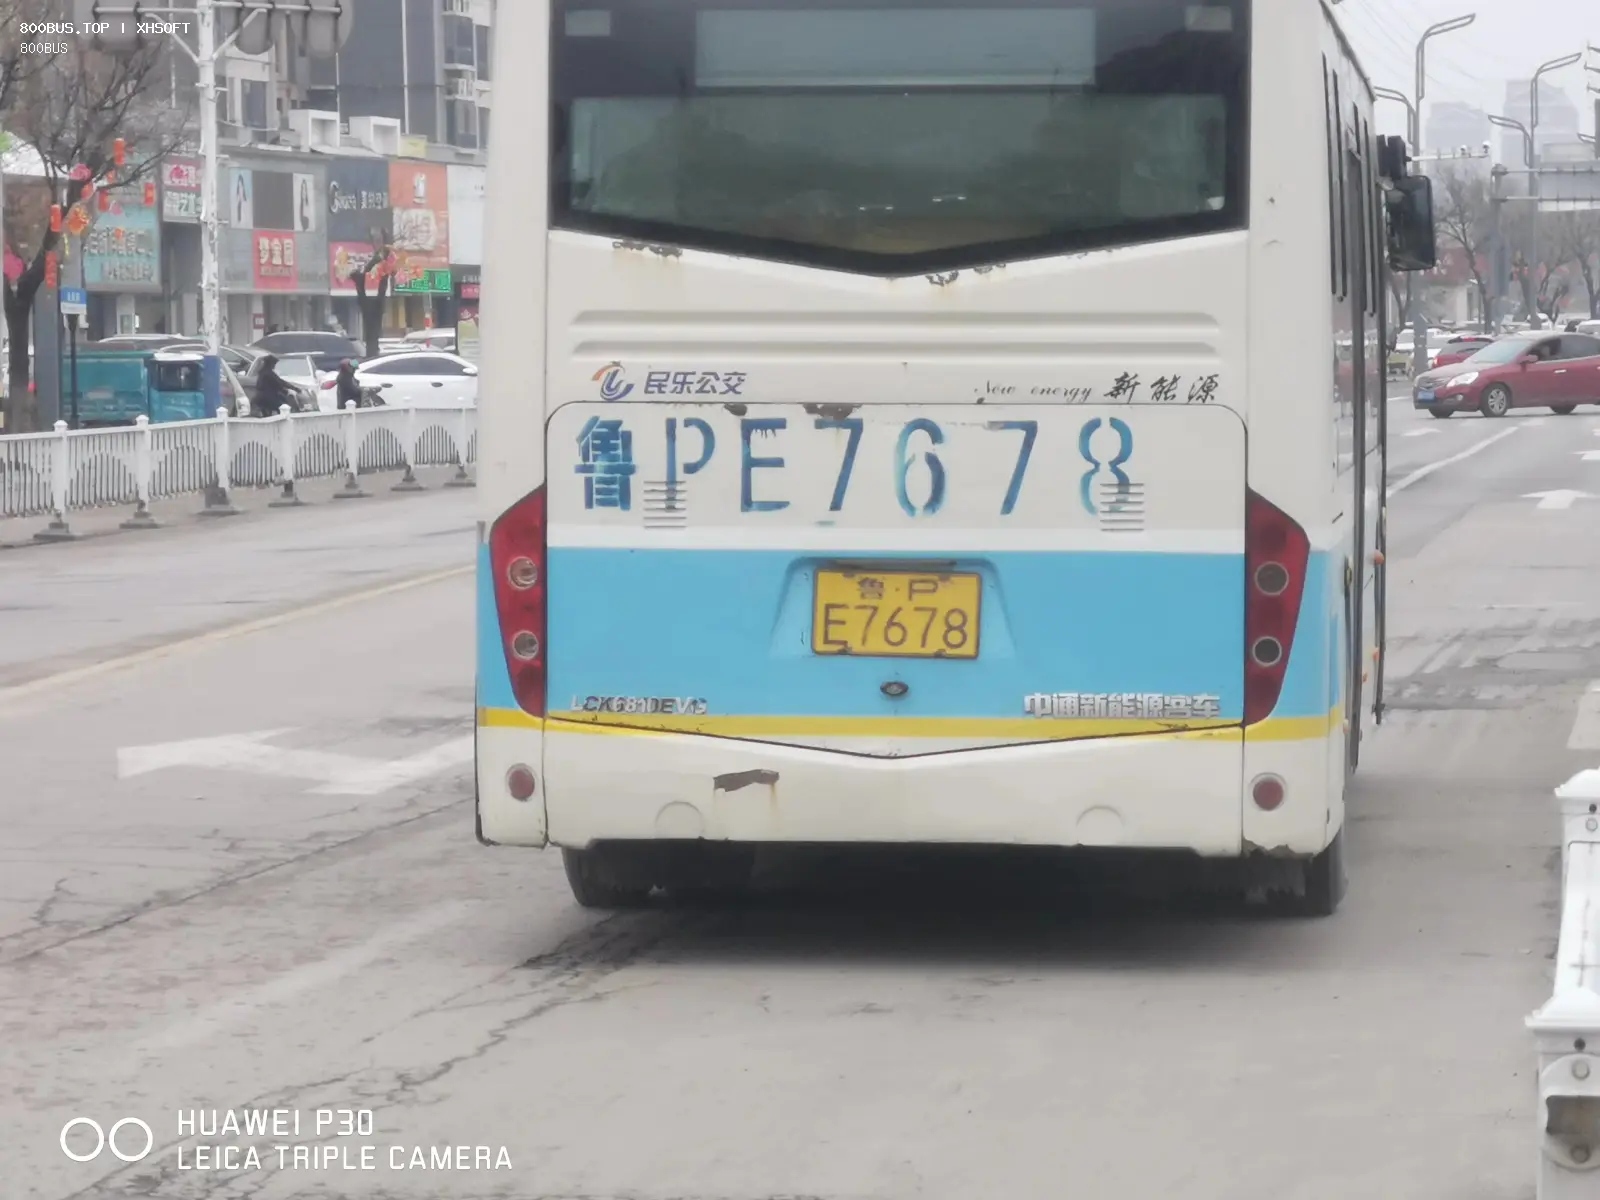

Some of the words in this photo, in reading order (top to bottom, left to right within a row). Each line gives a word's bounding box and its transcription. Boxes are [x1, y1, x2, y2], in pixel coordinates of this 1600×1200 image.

[643, 371, 747, 395] 民乐公交
[822, 602, 969, 650] E7678
[1023, 692, 1221, 719] 中通新能源客车
